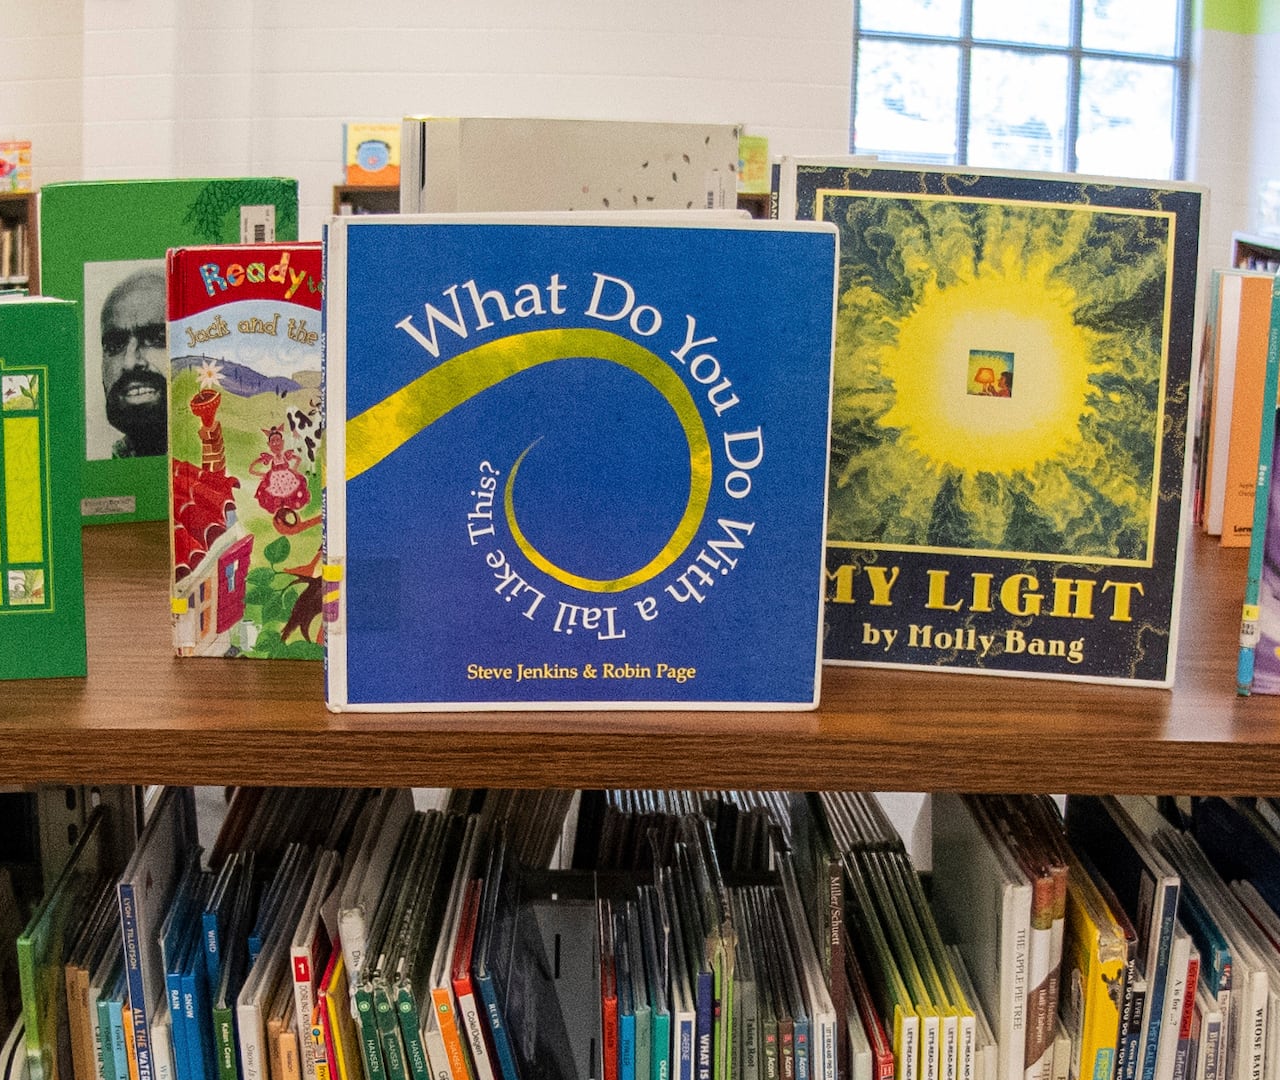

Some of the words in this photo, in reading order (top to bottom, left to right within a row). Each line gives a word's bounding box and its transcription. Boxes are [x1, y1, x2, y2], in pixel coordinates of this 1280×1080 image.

[199, 252, 307, 299] Ready
[395, 273, 568, 358] What
[584, 272, 662, 336] Do
[185, 314, 230, 348] Jack
[238, 313, 280, 336] and
[288, 319, 319, 346] the
[671, 314, 740, 417] You
[724, 426, 764, 499] Do
[1258, 464, 1267, 486] Bees
[467, 460, 500, 546] This?
[665, 517, 755, 604] With
[485, 549, 546, 620] Like
[824, 564, 900, 606] MY
[925, 569, 1145, 622] LIGHT
[553, 601, 626, 640] Tail
[634, 596, 659, 622] a
[862, 623, 898, 652] by
[908, 624, 995, 657] Molly
[1004, 629, 1085, 664] Bang
[467, 664, 513, 680] Steve
[516, 663, 578, 682] Jenkins
[582, 664, 598, 679] &
[602, 663, 651, 679] Robin
[656, 664, 696, 683] Page
[830, 875, 842, 946] Miller/Schuett
[208, 929, 218, 953] WIND
[1016, 928, 1026, 949] THE
[1014, 951, 1024, 985] APPLE
[171, 989, 181, 1010] RAIN
[184, 992, 195, 1019] SNOW
[1013, 986, 1023, 1004] PIE
[133, 1007, 143, 1026] ALL
[466, 1010, 484, 1056] Cole/Degen
[1012, 1005, 1022, 1031] TREE
[1254, 1008, 1263, 1057] WHOSE
[136, 1027, 146, 1047] THE
[699, 1033, 711, 1066] WHAT
[367, 1039, 380, 1074] HANSEN
[699, 1069, 710, 1080] IS
